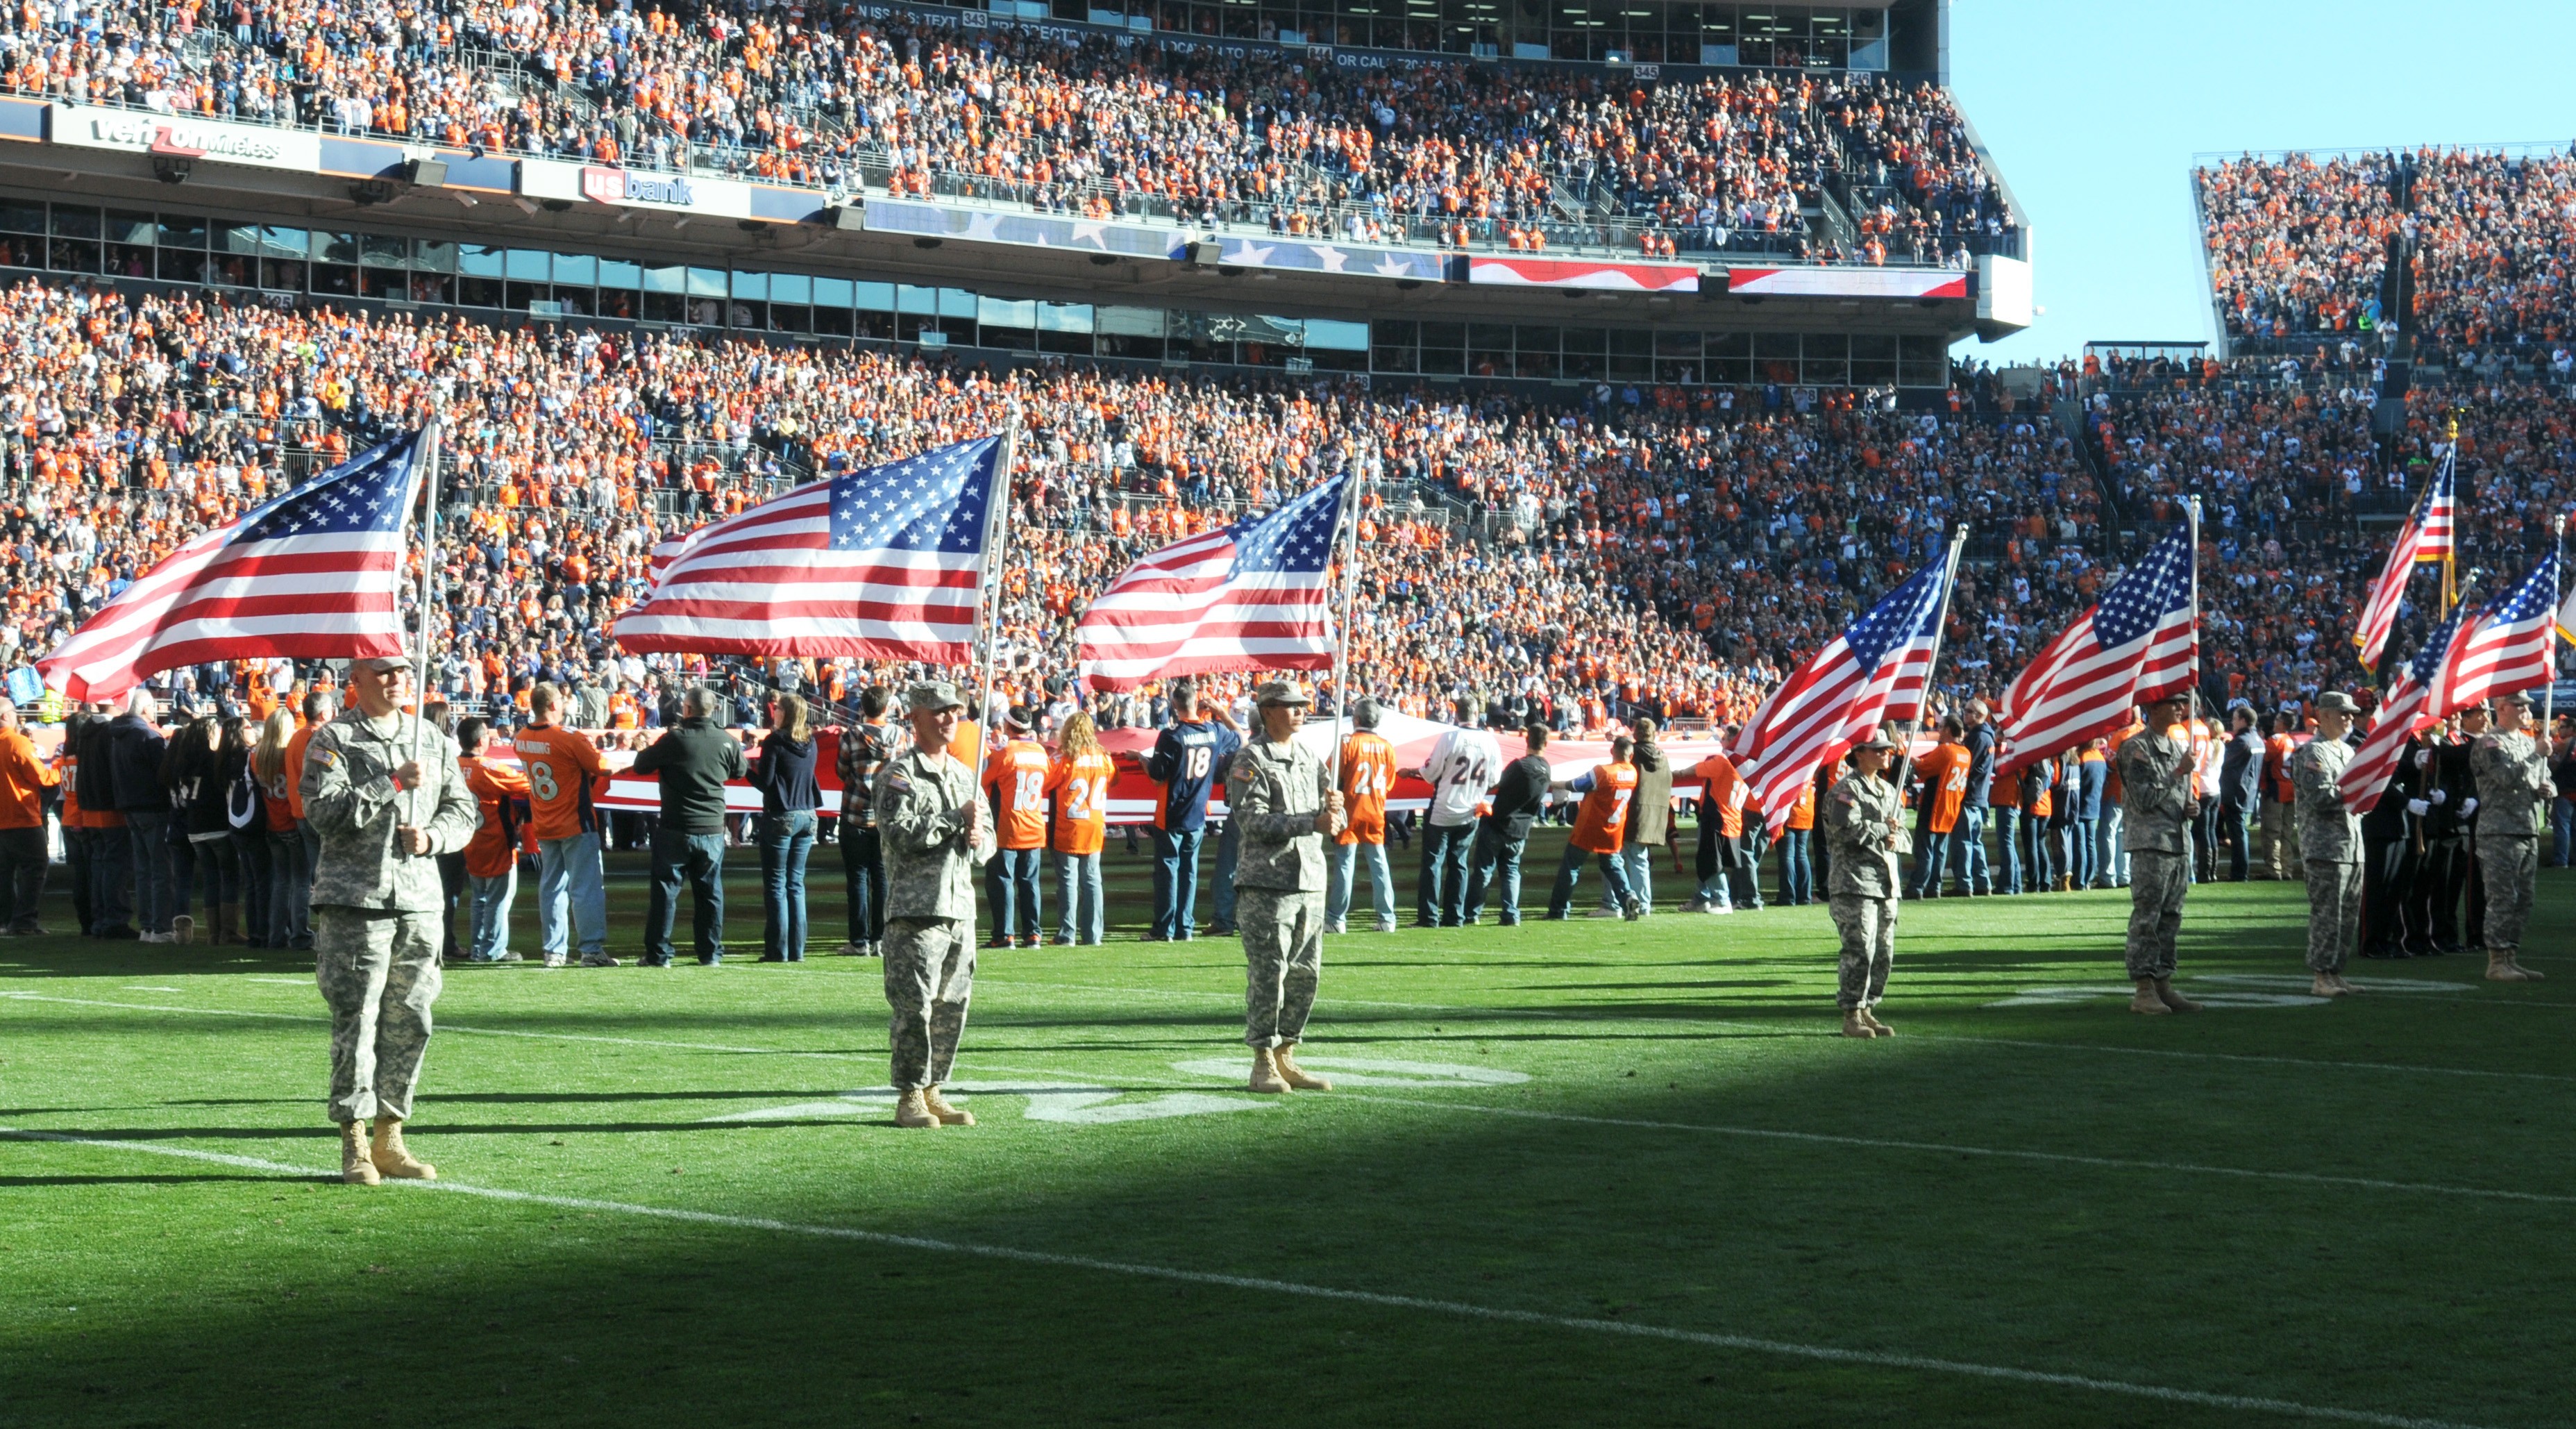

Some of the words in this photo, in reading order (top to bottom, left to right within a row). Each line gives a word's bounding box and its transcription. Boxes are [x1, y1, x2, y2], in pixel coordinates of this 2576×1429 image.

[923, 13, 957, 28] TEXT
[964, 12, 986, 26] 343
[1337, 54, 1356, 67] OR
[1360, 56, 1390, 68] CAL
[1635, 67, 1657, 78] 345
[1849, 73, 1869, 85] 346
[1186, 746, 1211, 780] 18
[1451, 755, 1486, 787] 24
[60, 765, 78, 792] 87
[1013, 771, 1045, 811] 18
[1354, 761, 1387, 796] 24
[1946, 766, 1969, 792] 24
[1067, 776, 1107, 819] 24
[1607, 788, 1633, 824] 7
[1728, 780, 1750, 811] 18
